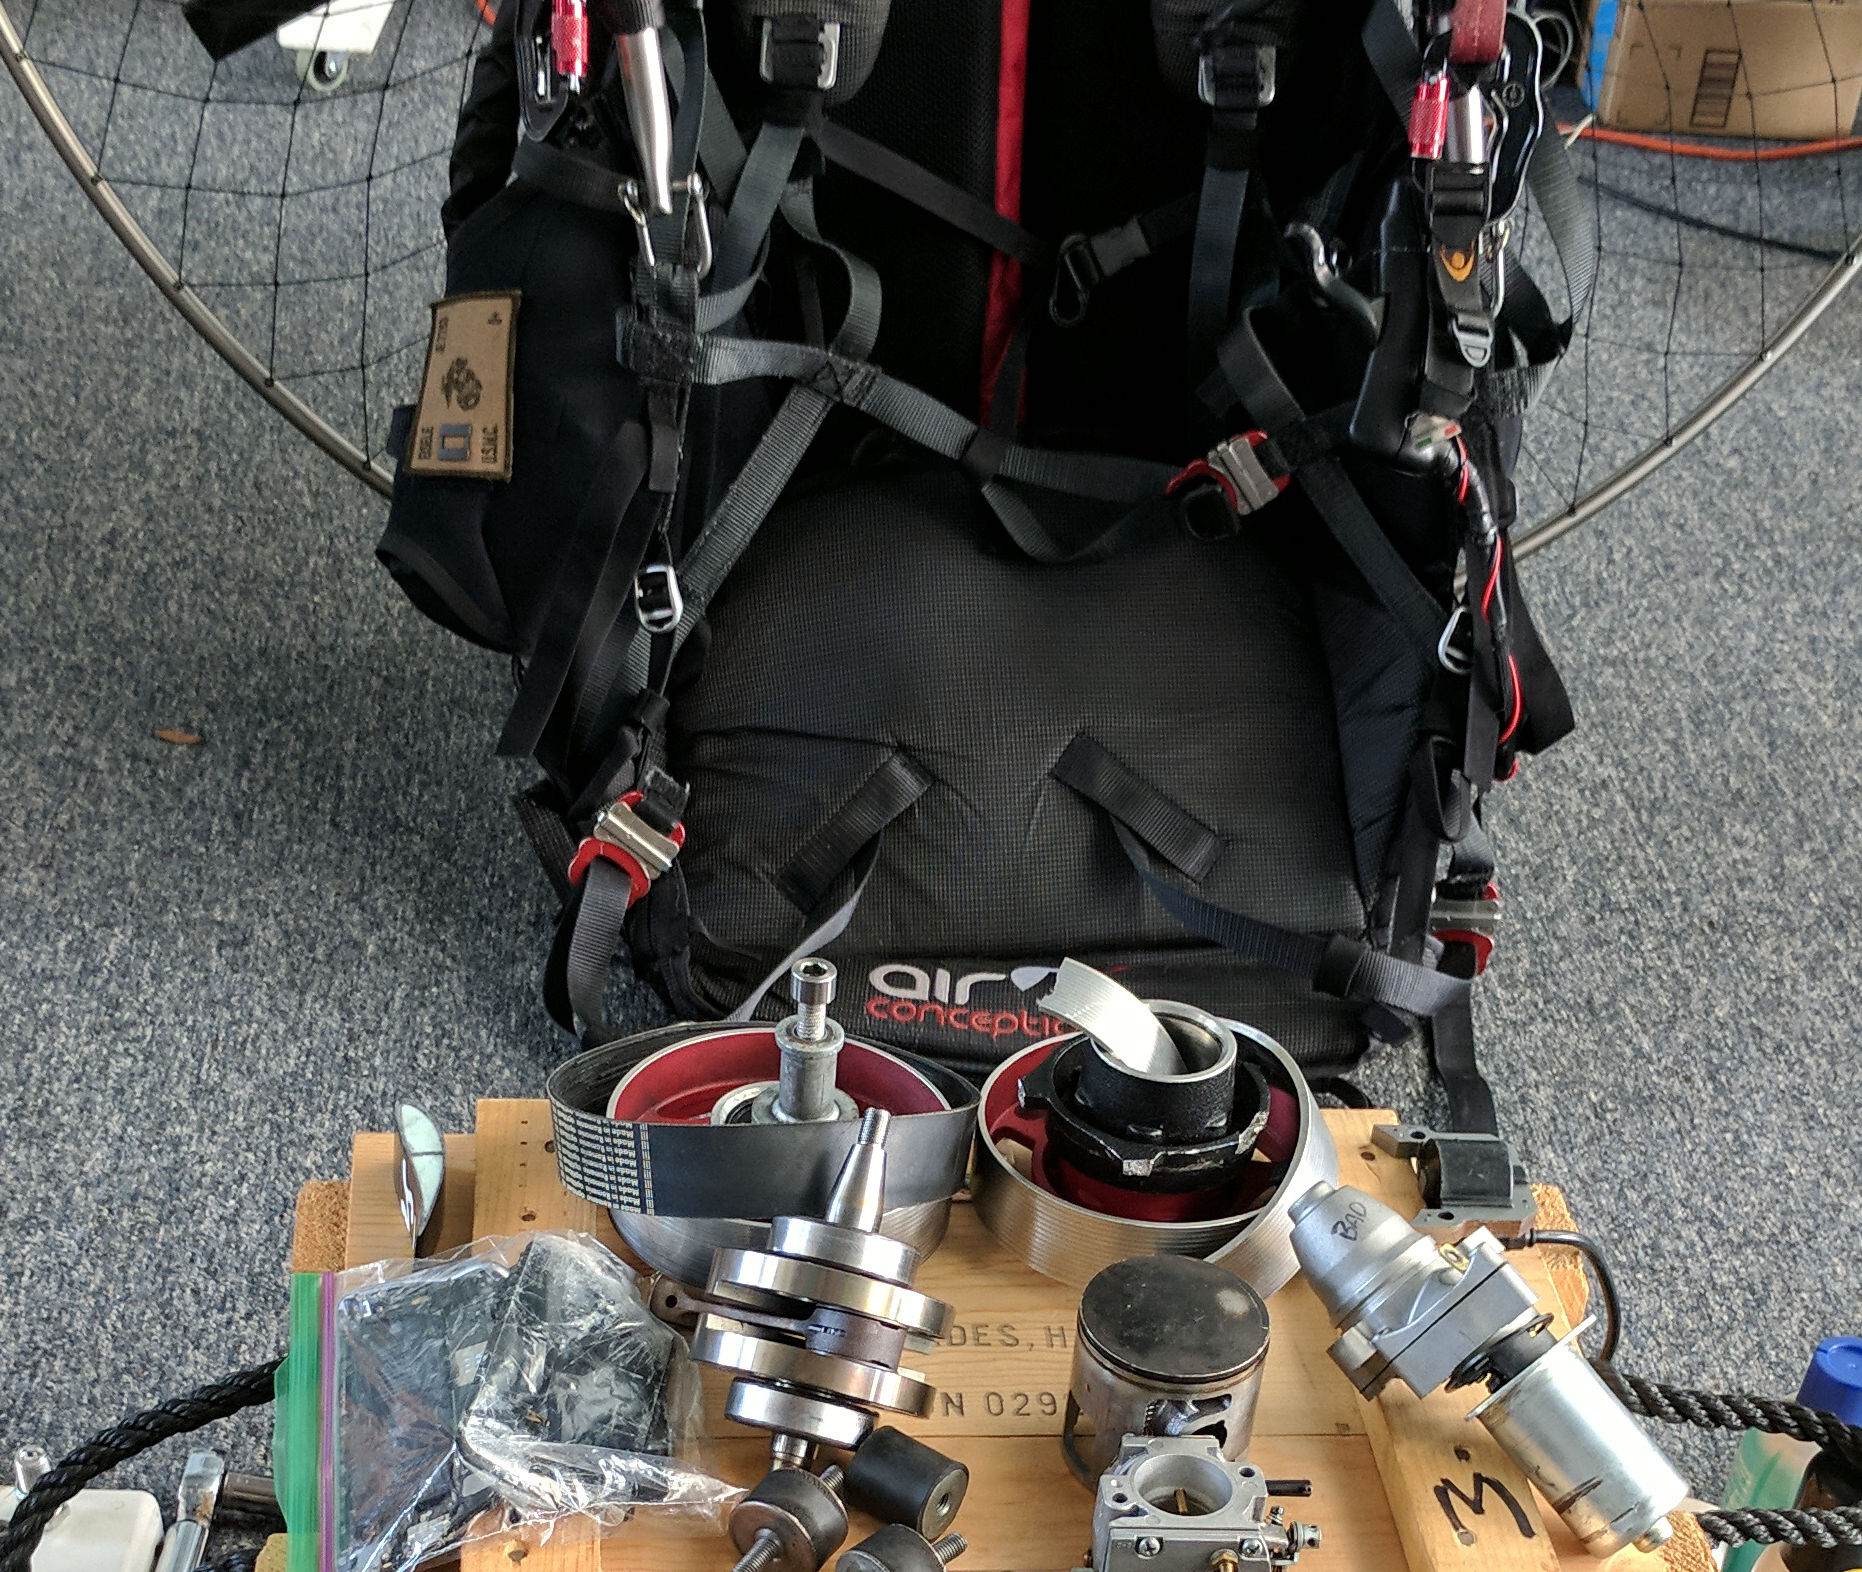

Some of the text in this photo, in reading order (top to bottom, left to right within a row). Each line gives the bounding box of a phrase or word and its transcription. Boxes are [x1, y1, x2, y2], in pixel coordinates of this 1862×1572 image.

[869, 963, 1007, 1006] air
[866, 996, 1082, 1040] conceptio
[1330, 1201, 1367, 1241] BAD
[937, 1324, 1035, 1351] DES,
[987, 1392, 1070, 1417] 029
